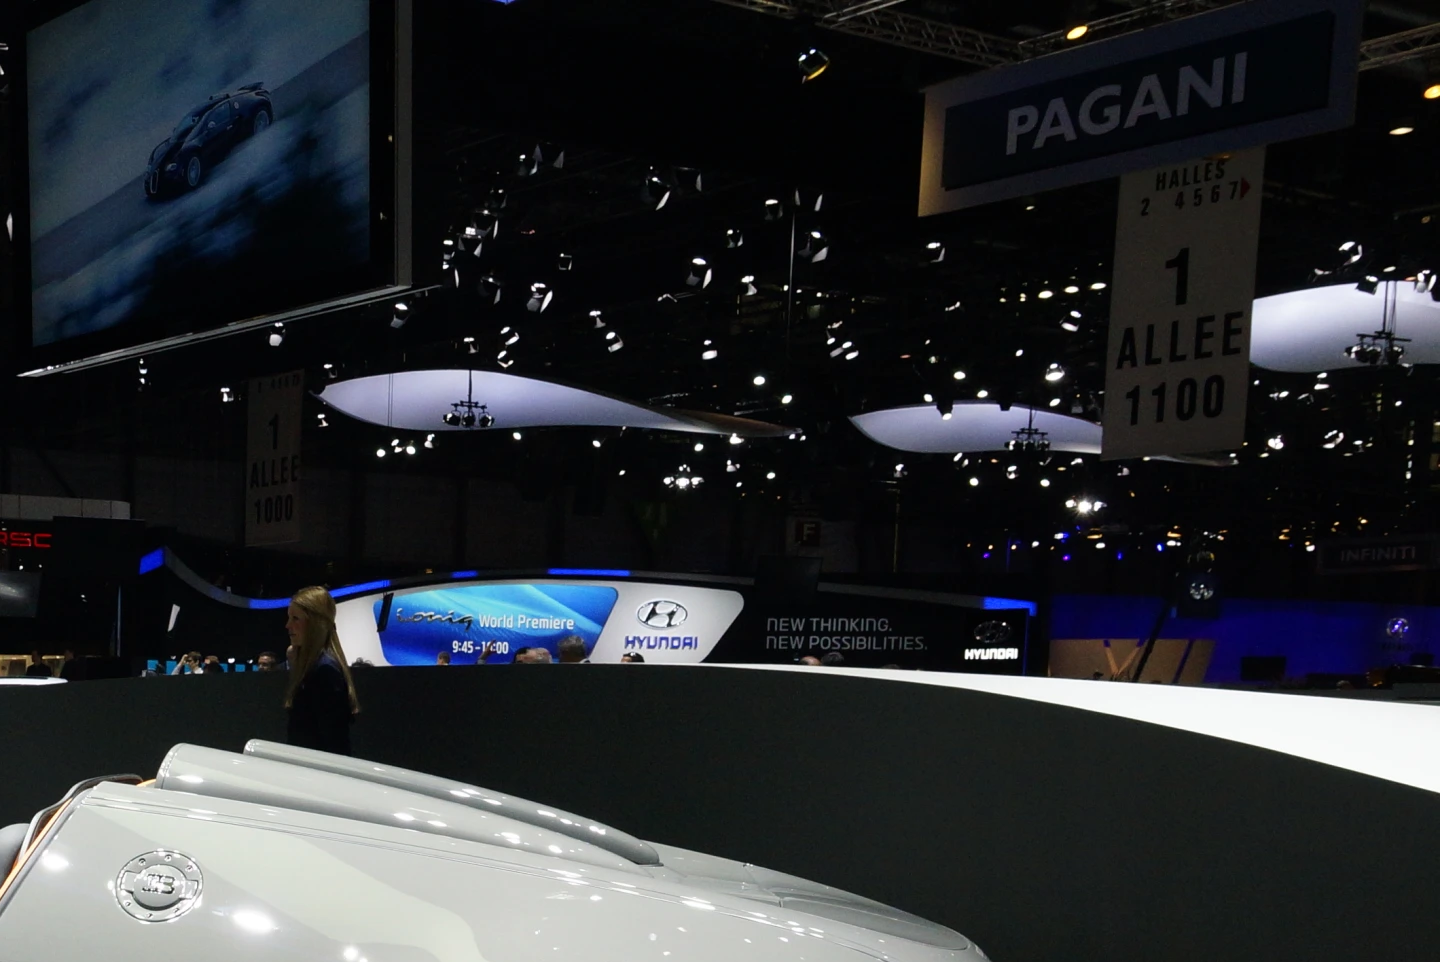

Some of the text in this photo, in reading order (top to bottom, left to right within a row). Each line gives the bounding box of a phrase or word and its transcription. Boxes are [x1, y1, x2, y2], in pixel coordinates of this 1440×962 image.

[1006, 51, 1248, 156] PAGANI
[1155, 160, 1225, 191] HALLES
[1141, 180, 1238, 216] 2 4 5 6 7
[1165, 247, 1190, 306] 1
[1116, 311, 1244, 370] ALLEE
[1126, 374, 1225, 426] 1100
[269, 413, 279, 450] 1
[250, 454, 299, 489] ALLEE
[254, 494, 294, 525] 1000
[1341, 546, 1416, 562] INFINITI
[479, 613, 514, 628] World
[517, 614, 575, 630] Premiere
[766, 617, 893, 632] NEW THINKING.
[624, 635, 698, 650] HYUNDAI
[765, 635, 928, 650] NEW POSSIBILITIES.
[964, 648, 1019, 661] HYUNDAI
